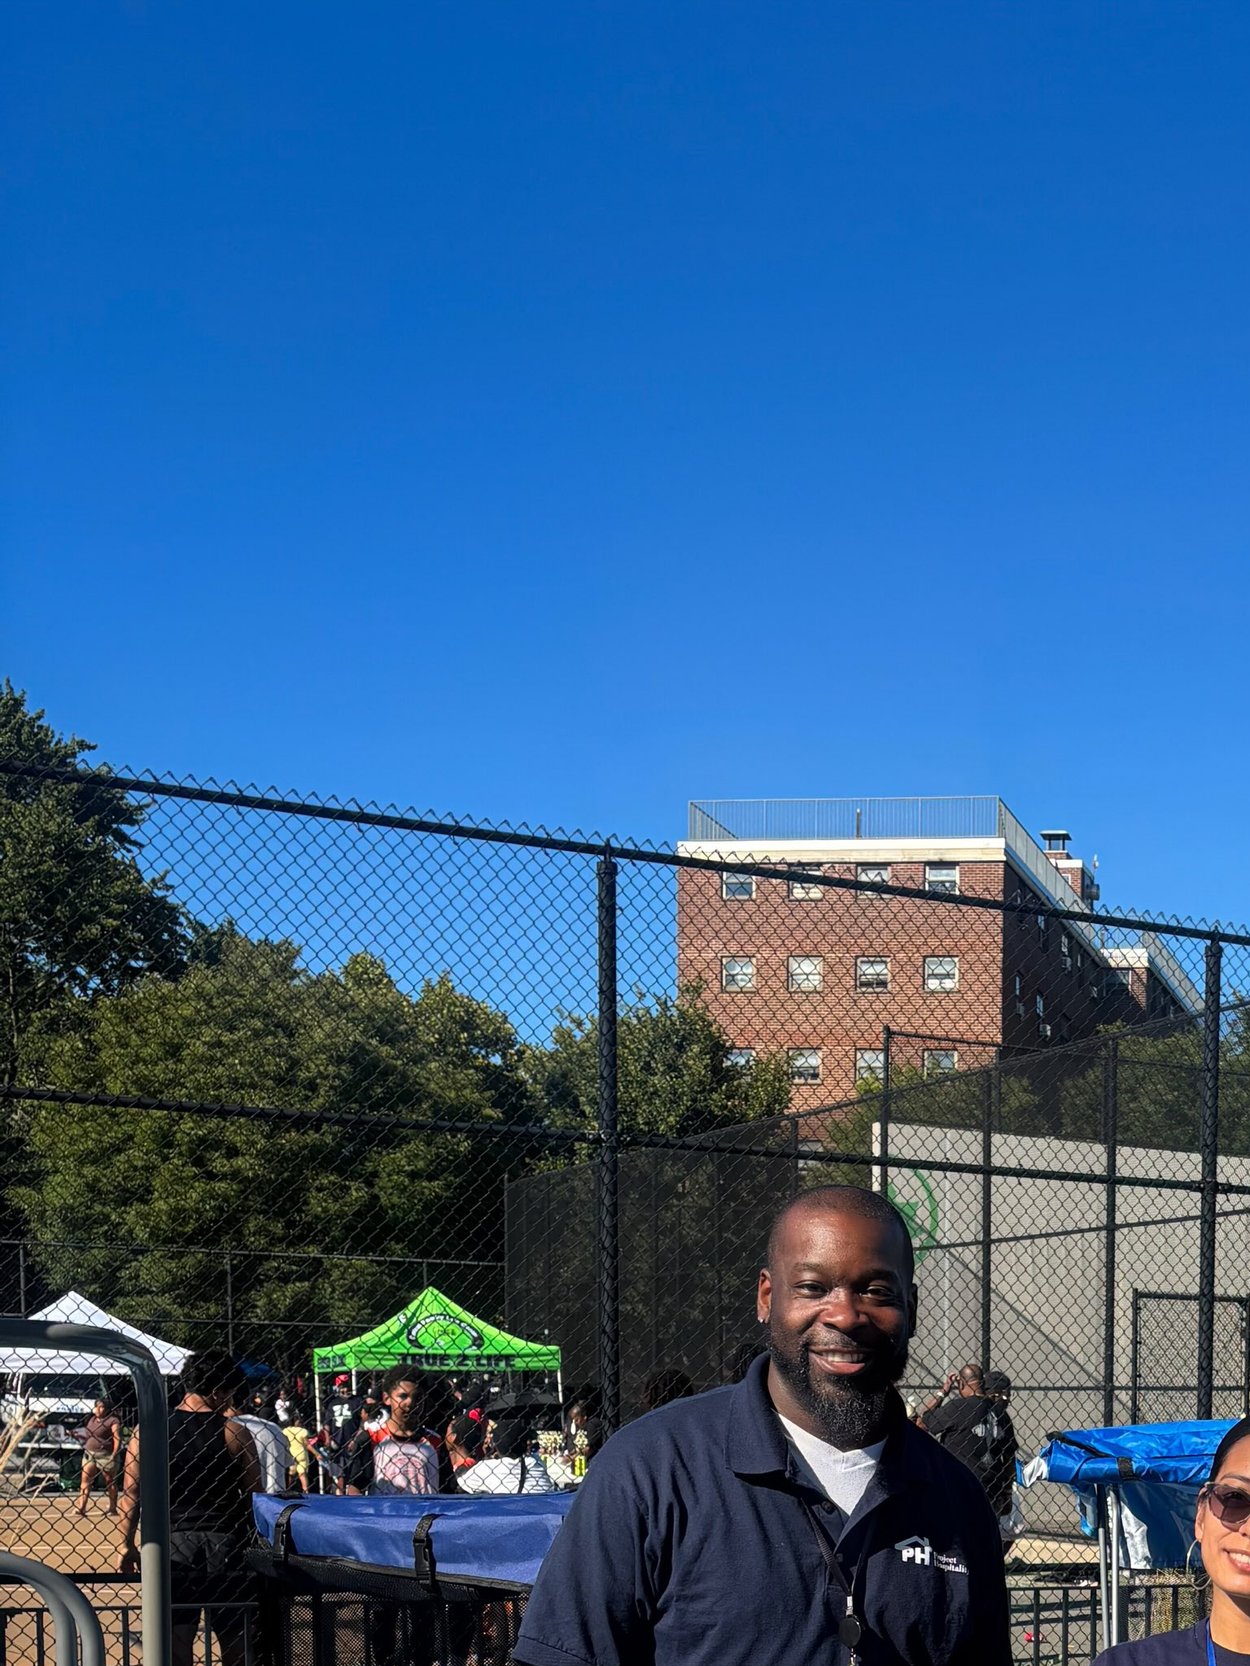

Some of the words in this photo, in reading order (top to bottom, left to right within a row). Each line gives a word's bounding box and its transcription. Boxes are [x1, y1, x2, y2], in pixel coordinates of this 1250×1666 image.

[401, 1354, 451, 1367] TRUE
[456, 1354, 472, 1368] 2
[476, 1354, 518, 1368] LIFE
[900, 1540, 932, 1566] PH
